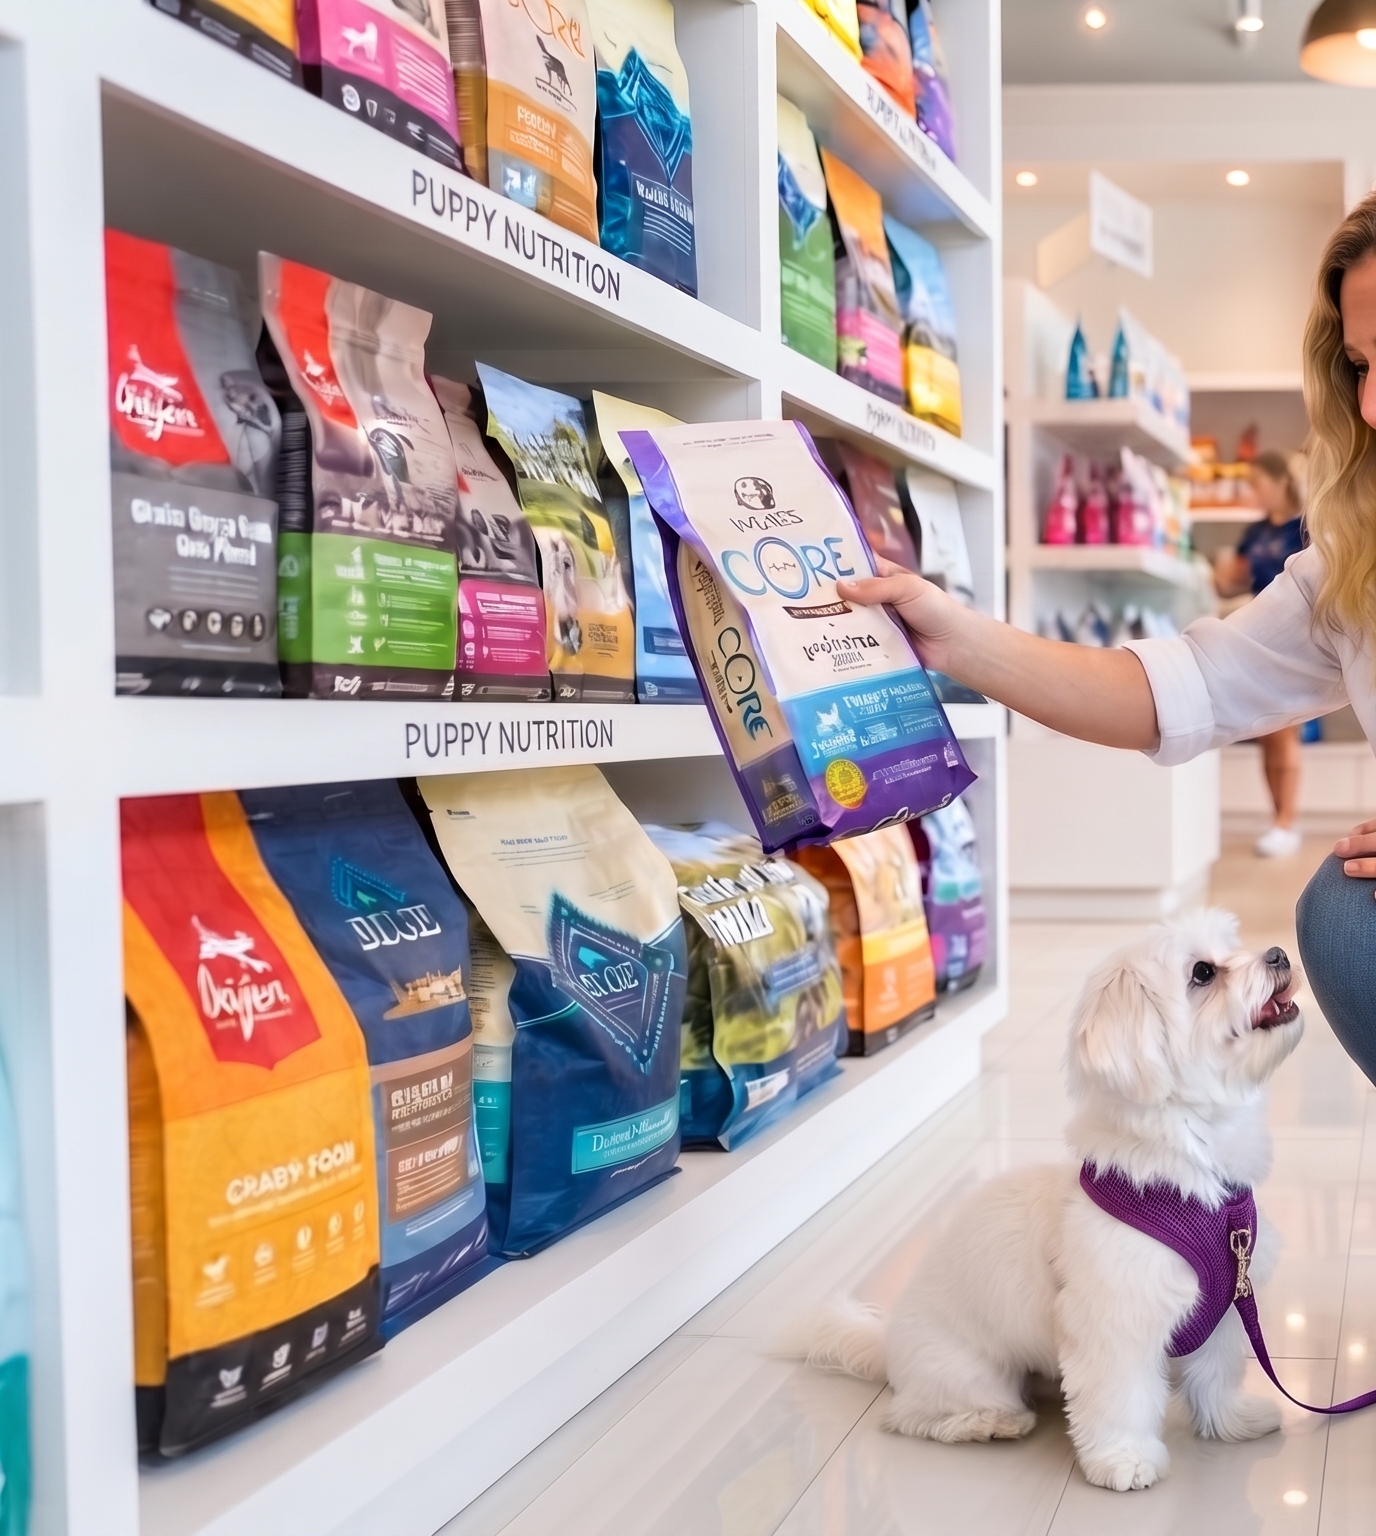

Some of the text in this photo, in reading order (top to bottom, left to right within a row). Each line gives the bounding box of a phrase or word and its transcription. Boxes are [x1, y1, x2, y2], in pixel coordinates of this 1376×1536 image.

[411, 168, 620, 301] PUPPY NUTRITION
[721, 536, 856, 600] CORE
[717, 626, 774, 741] CORE
[405, 719, 613, 759] PUPPY NUTRITION
